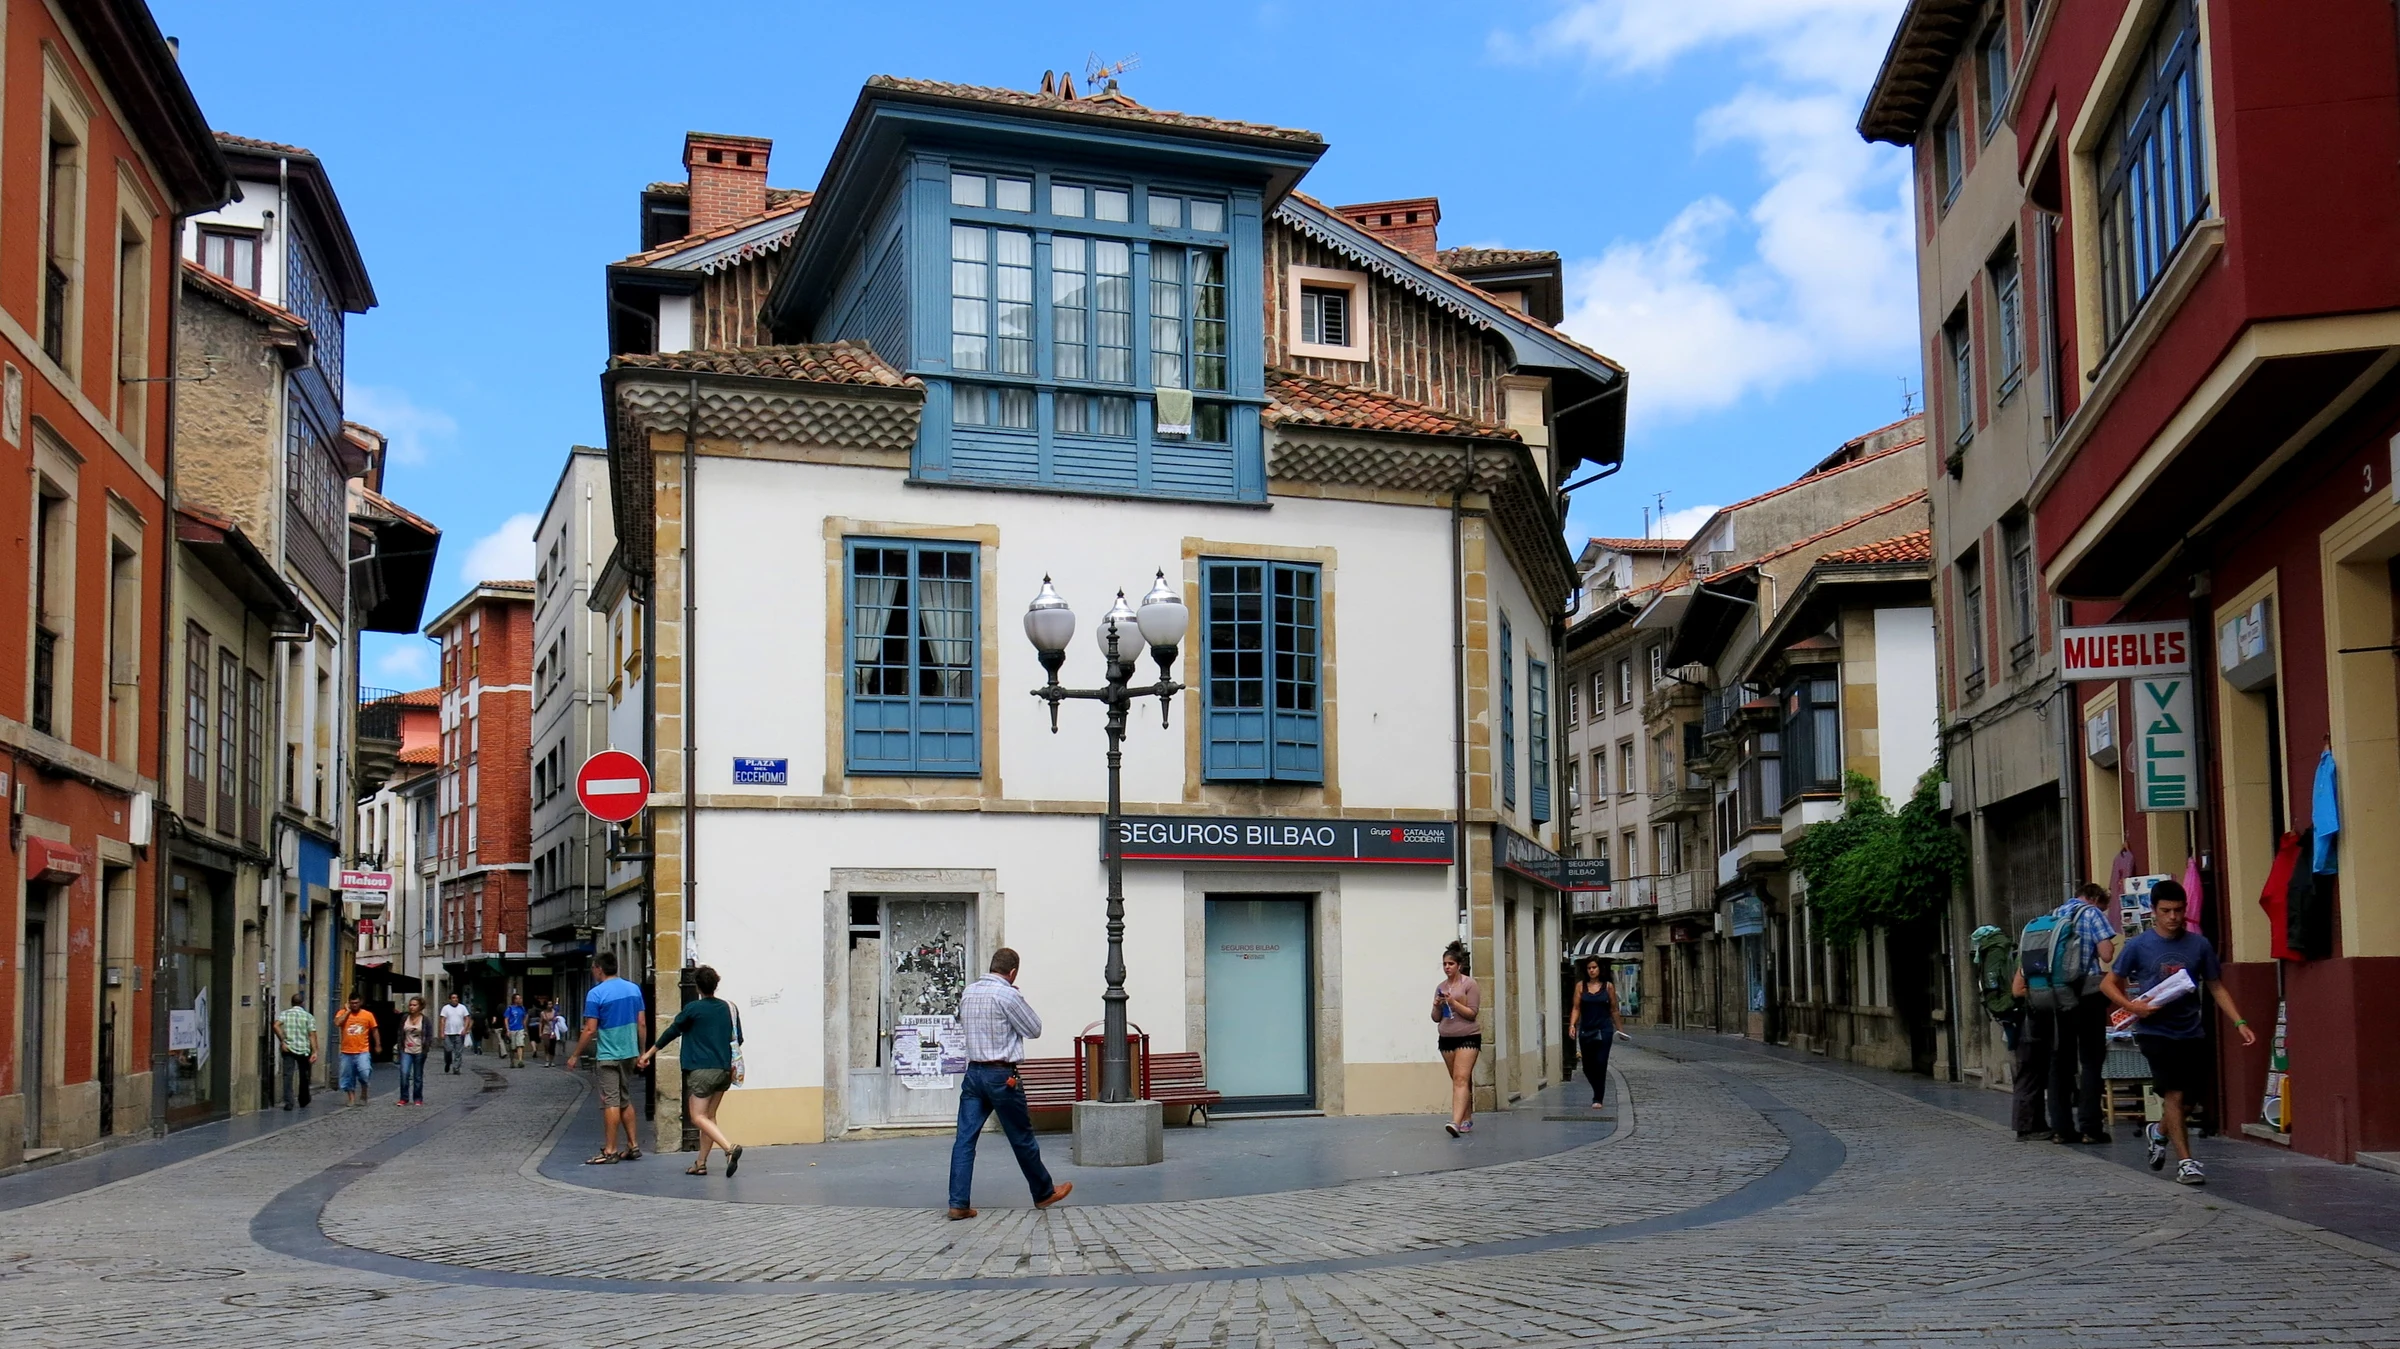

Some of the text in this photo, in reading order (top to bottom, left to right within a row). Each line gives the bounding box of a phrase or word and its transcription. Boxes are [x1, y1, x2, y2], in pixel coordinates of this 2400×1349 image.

[2363, 464, 2373, 493] 3
[2064, 631, 2186, 669] MUEBLES
[2144, 681, 2186, 807] VALLE
[745, 759, 775, 767] PLAZA
[735, 771, 785, 783] ECCEHOMO
[1120, 822, 1336, 847] SEGUROS BILBAO
[1370, 827, 1392, 837] Grupo
[1403, 828, 1446, 836] CATALANA
[1403, 836, 1446, 844] OCCIDENTE
[1568, 860, 1605, 868] SEGUROS
[343, 874, 387, 886] Mahou
